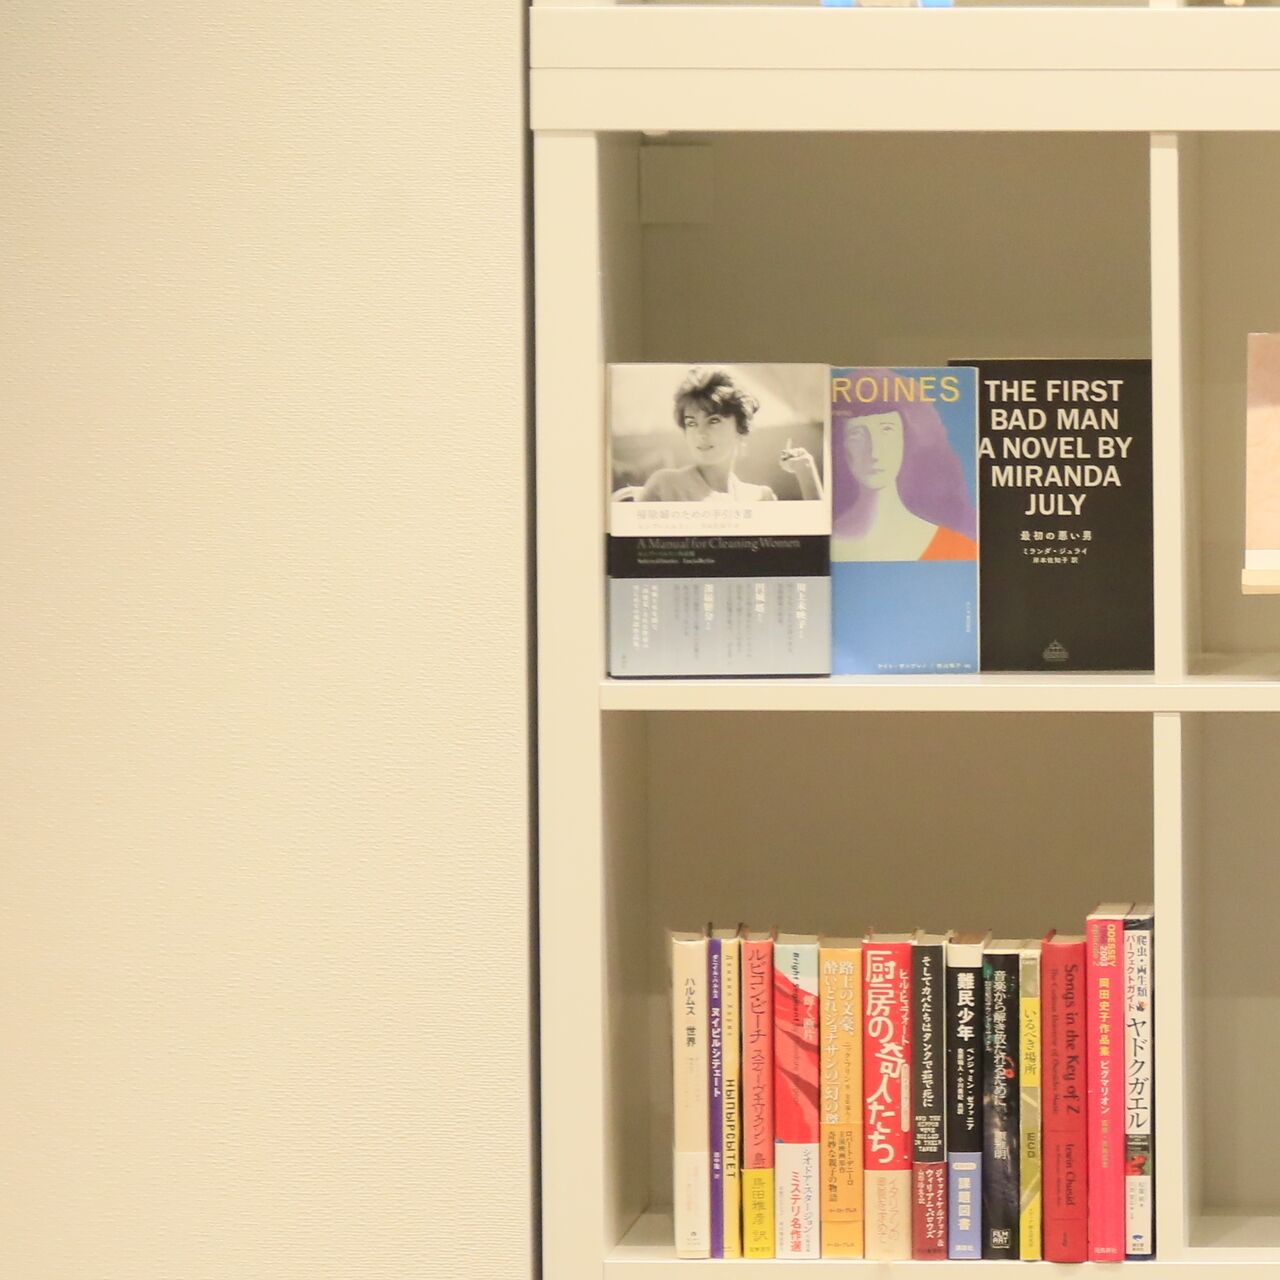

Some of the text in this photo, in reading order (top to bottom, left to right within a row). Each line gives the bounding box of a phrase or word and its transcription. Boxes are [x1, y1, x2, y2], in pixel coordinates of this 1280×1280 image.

[985, 380, 1123, 401] THE FIRST
[991, 409, 1118, 430] BAD MAN
[979, 437, 1132, 458] A NOVEL BY
[992, 466, 1121, 486] MIRANDA
[1025, 494, 1086, 515] JULY
[1020, 531, 1092, 541] 最初の悪い男
[749, 949, 766, 1045] ルビコン・ビーチ
[957, 972, 975, 1042] 難民少年
[866, 950, 903, 1164] 厨房の奇人たち
[921, 956, 934, 1107] そしてカバたちはタンクで茹で死に
[1024, 1008, 1036, 1076] いるべき場所
[1063, 964, 1080, 1115] Songs in the Key of Z
[1099, 1060, 1109, 1115] ピグマリオン
[1126, 1017, 1149, 1130] ヤドクガエル
[1027, 1133, 1036, 1159] ECD
[790, 1171, 802, 1252] ミステリ名作選
